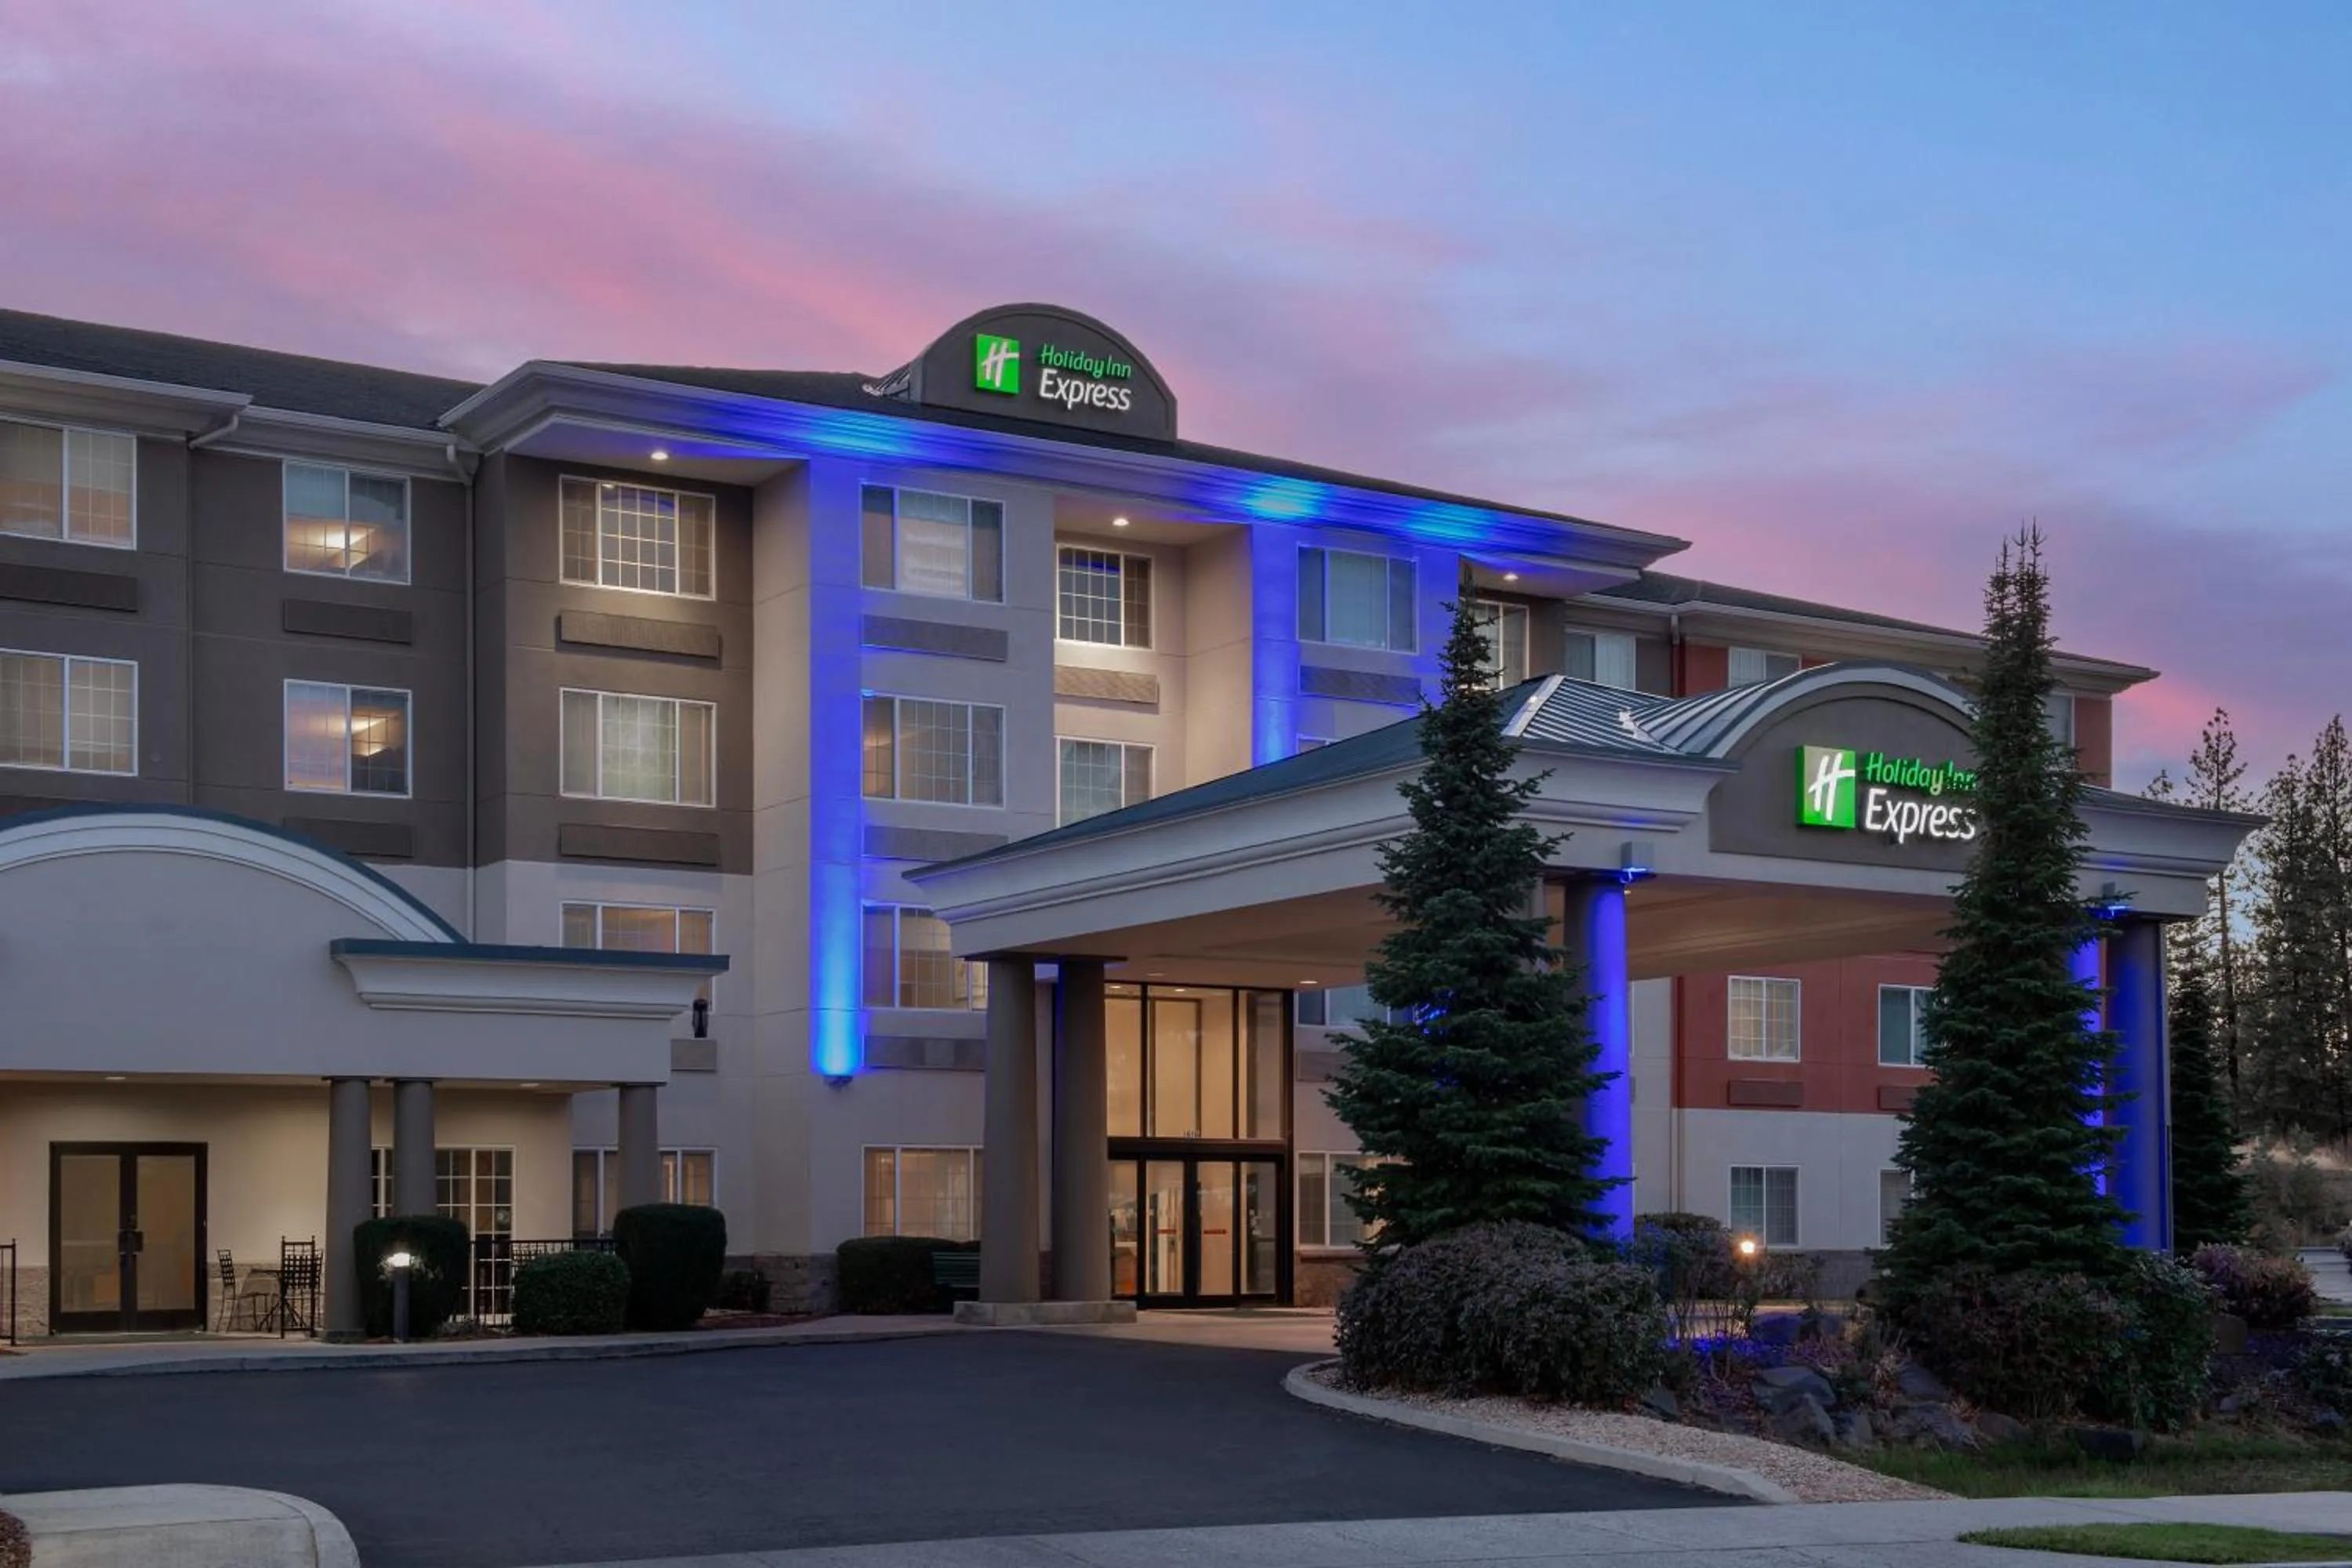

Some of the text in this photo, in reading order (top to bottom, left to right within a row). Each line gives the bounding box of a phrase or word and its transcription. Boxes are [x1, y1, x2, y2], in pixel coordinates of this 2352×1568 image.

[1041, 344, 1131, 378] Holiday Inn
[1040, 368, 1131, 410] Express
[1866, 752, 1944, 796] Holiday
[1865, 788, 1976, 844] Express
